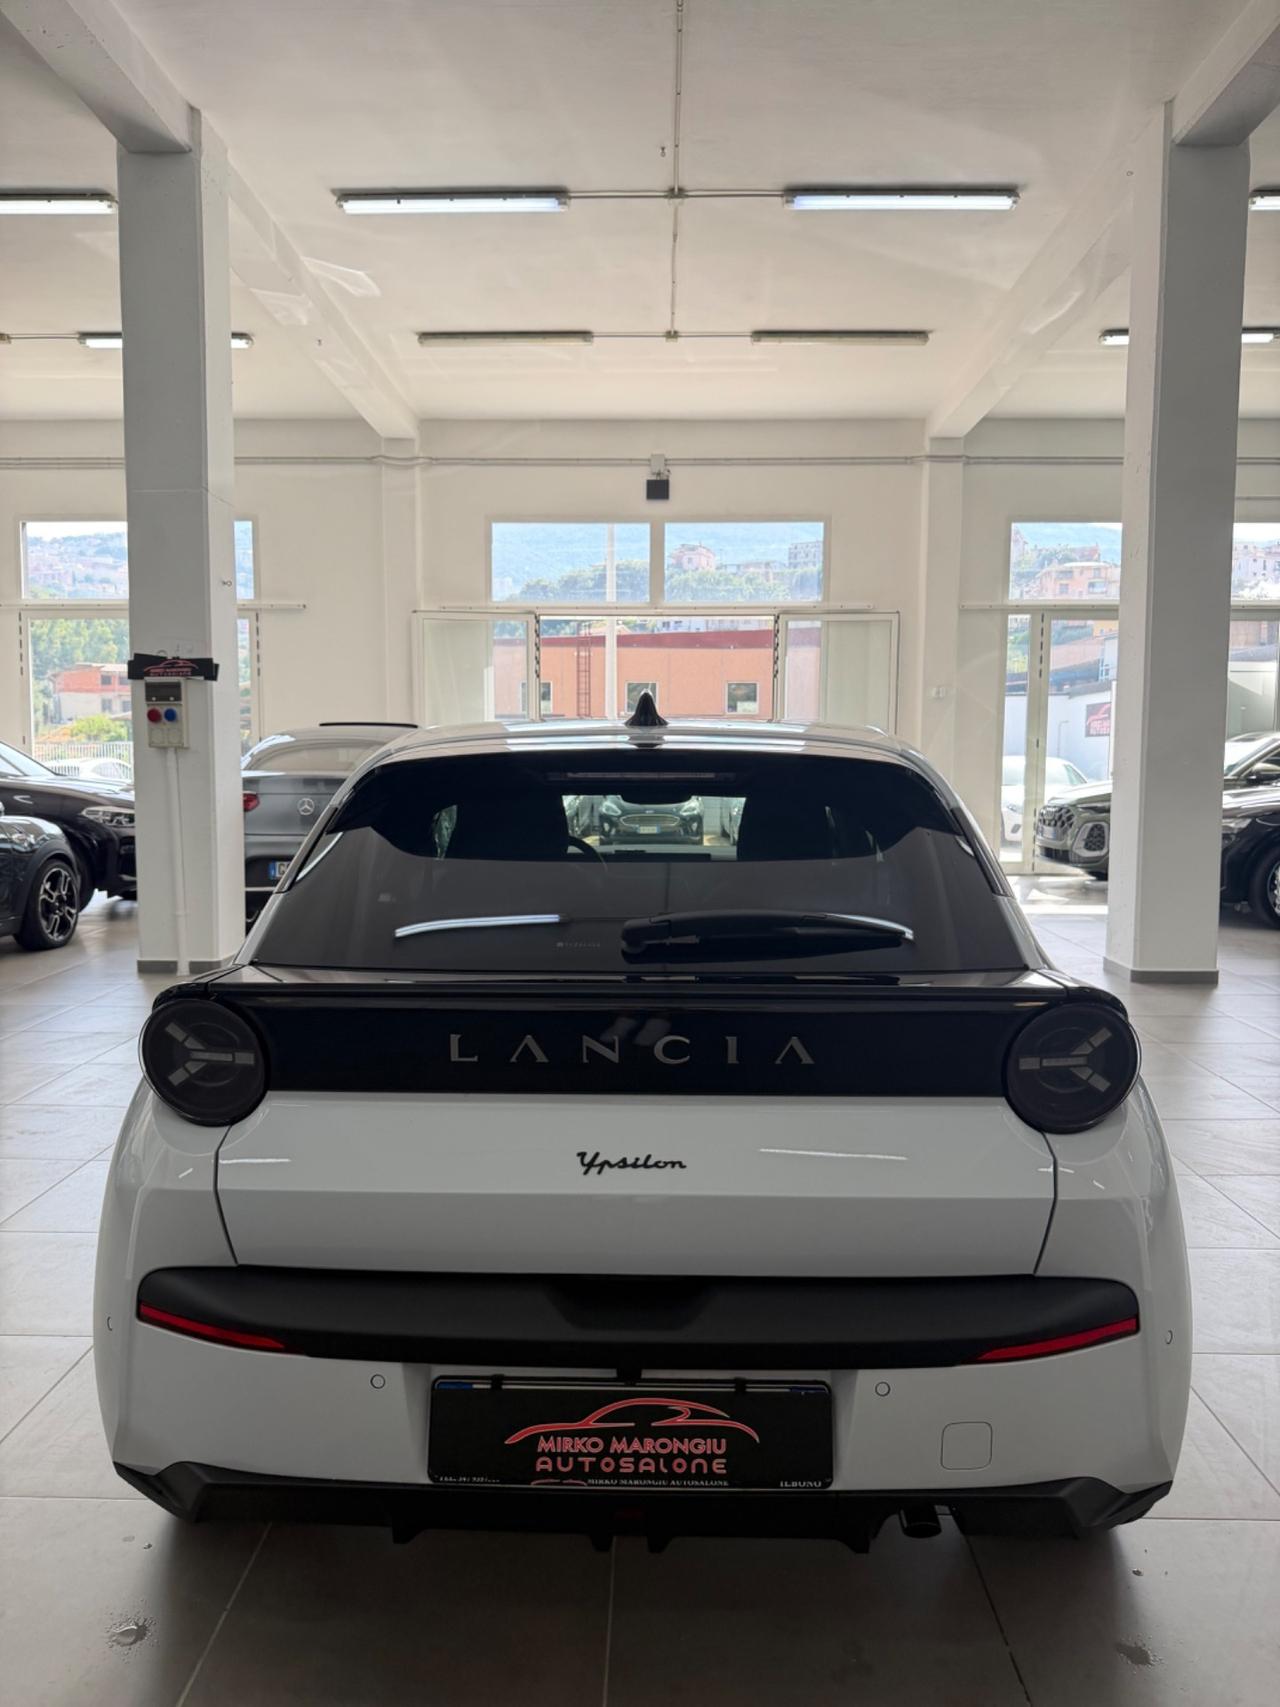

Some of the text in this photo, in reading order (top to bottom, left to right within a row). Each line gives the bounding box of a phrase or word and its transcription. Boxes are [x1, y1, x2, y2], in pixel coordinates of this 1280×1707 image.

[449, 1033, 815, 1065] LANCIA
[576, 1151, 688, 1176] Ypsilon
[537, 1435, 727, 1455] MIRKO MARONGIU
[535, 1456, 728, 1475] AUTOSALONE
